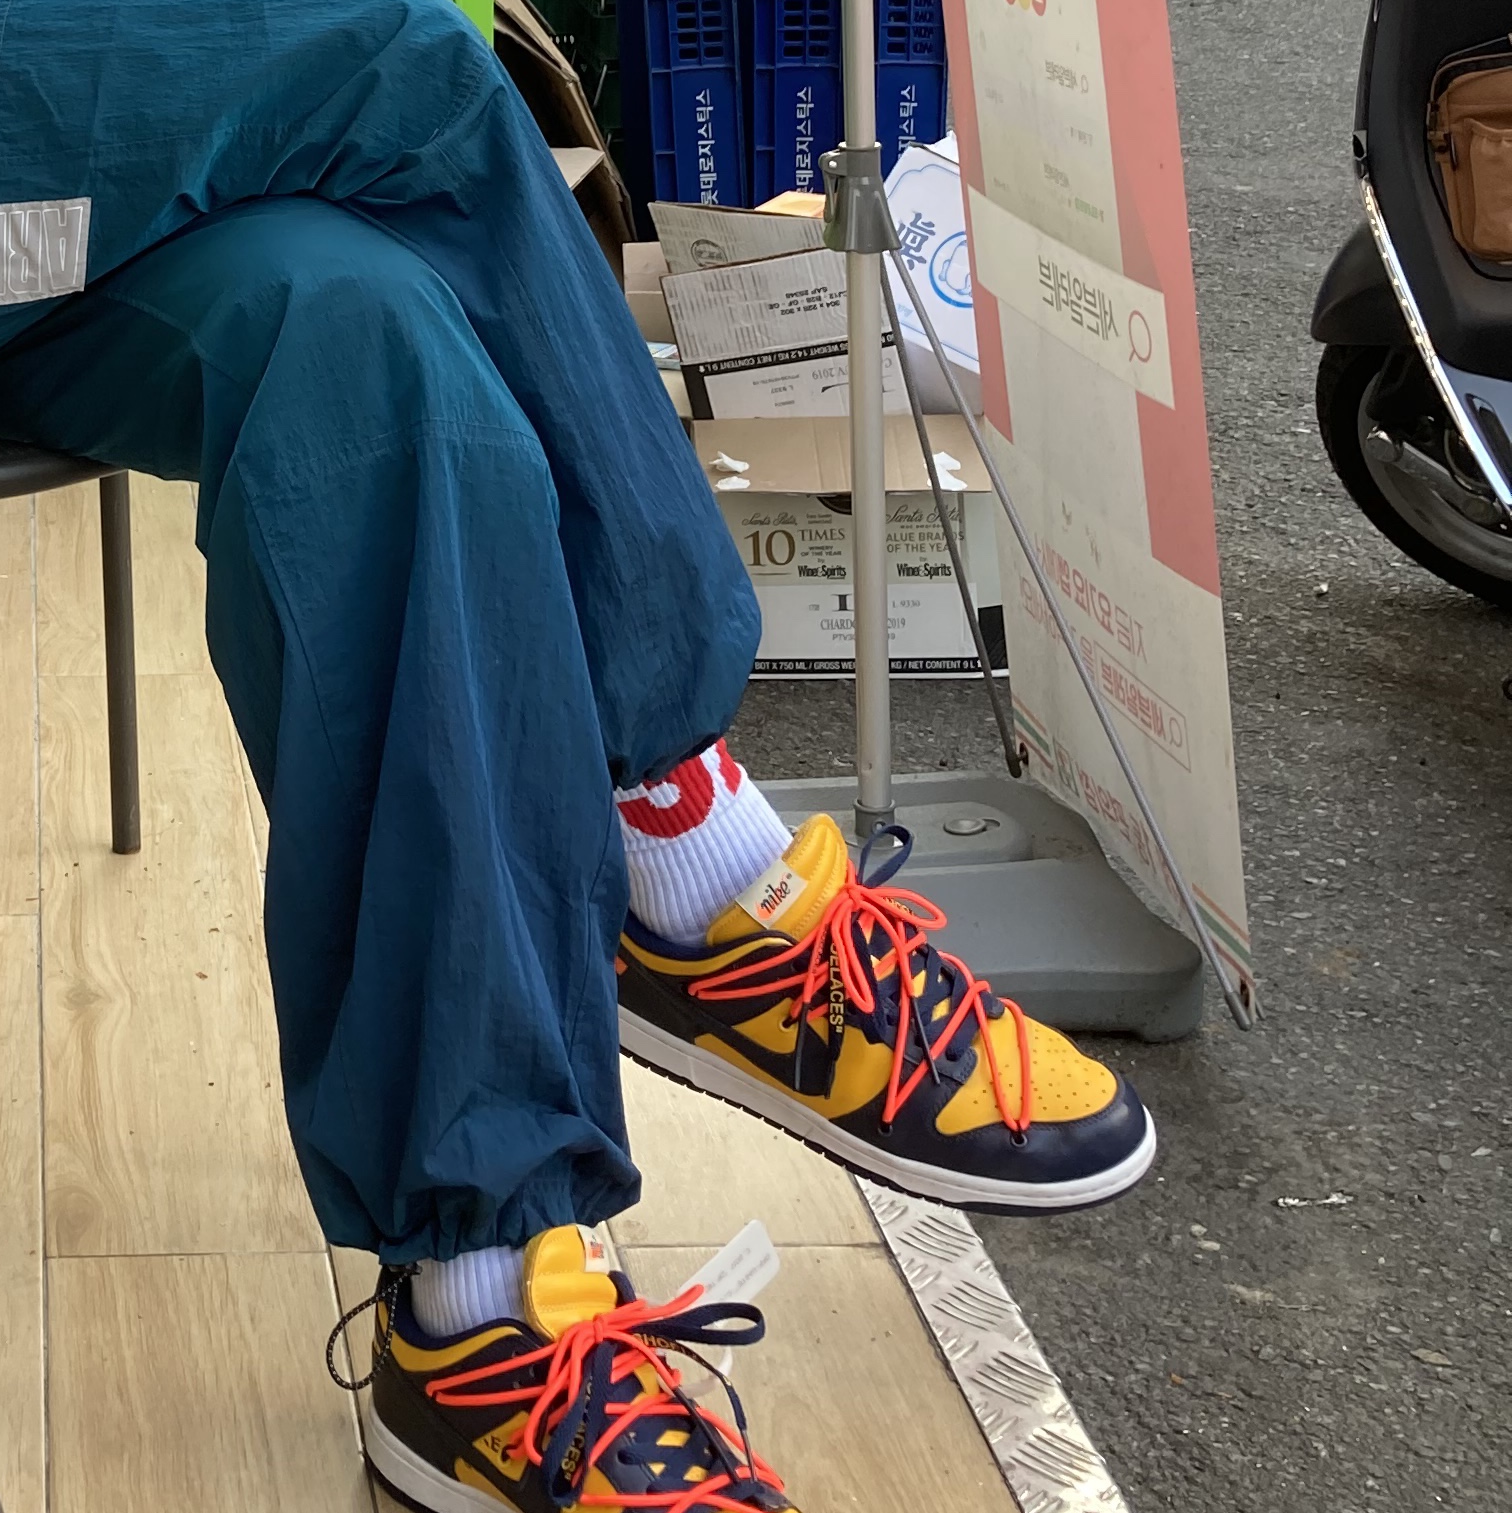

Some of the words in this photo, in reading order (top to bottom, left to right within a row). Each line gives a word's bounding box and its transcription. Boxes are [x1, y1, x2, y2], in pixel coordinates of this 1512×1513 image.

[812, 344, 838, 356] WEIGHT
[720, 357, 756, 370] CONTENT
[756, 355, 772, 365] NET
[812, 368, 835, 380] 2019
[798, 528, 846, 542] TIMES
[885, 531, 917, 542] ALUE
[744, 530, 796, 567] 10
[886, 543, 901, 554] OF
[904, 543, 926, 553] THE
[929, 542, 950, 553] YEA
[754, 662, 771, 670] BOT
[778, 661, 795, 670] 750
[796, 661, 808, 669] ML
[814, 661, 840, 670] GROSS
[890, 660, 902, 669] KG
[908, 660, 924, 669] NET
[925, 660, 961, 669] CONTENT
[760, 872, 795, 920] nike
